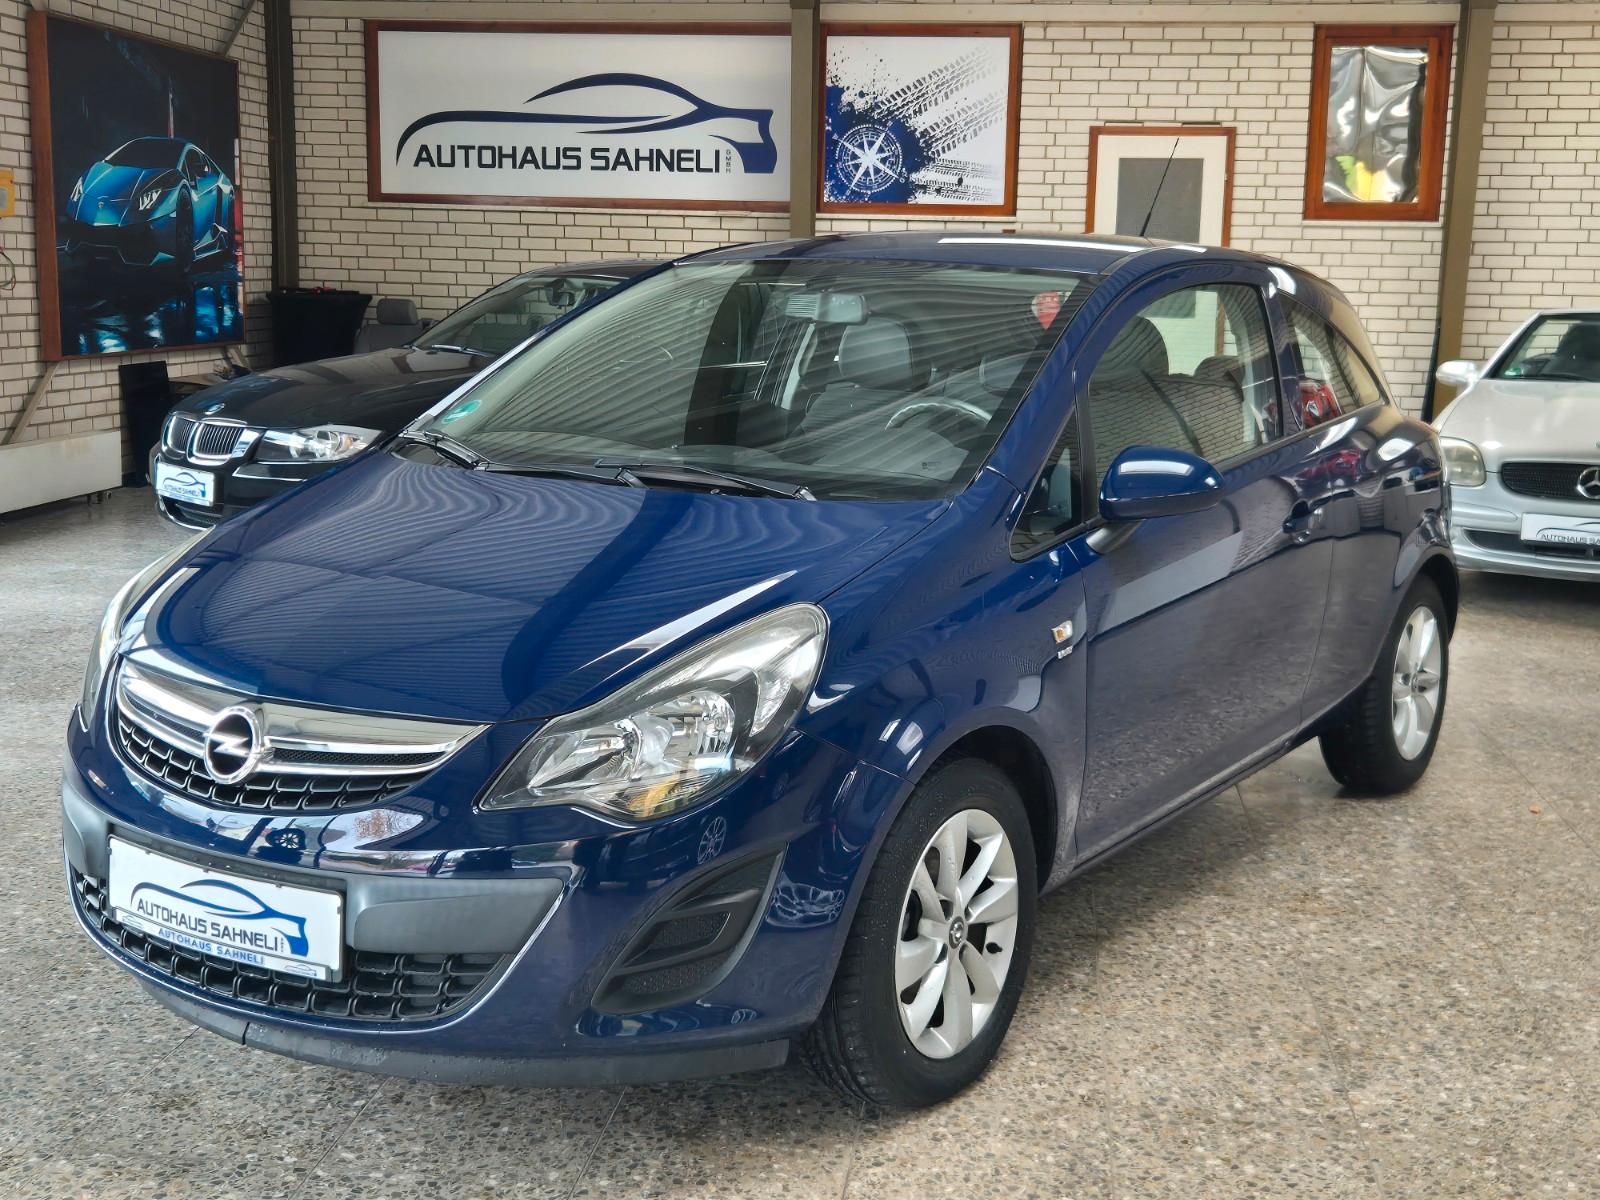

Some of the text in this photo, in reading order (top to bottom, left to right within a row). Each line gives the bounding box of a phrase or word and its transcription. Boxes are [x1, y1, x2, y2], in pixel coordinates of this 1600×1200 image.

[413, 144, 720, 173] AUTOHAUS SAHNELI
[137, 898, 207, 934] AUTOHAUS
[210, 921, 278, 952] SAHNELI
[158, 927, 264, 965] AUTOHAUS SAHNELI
